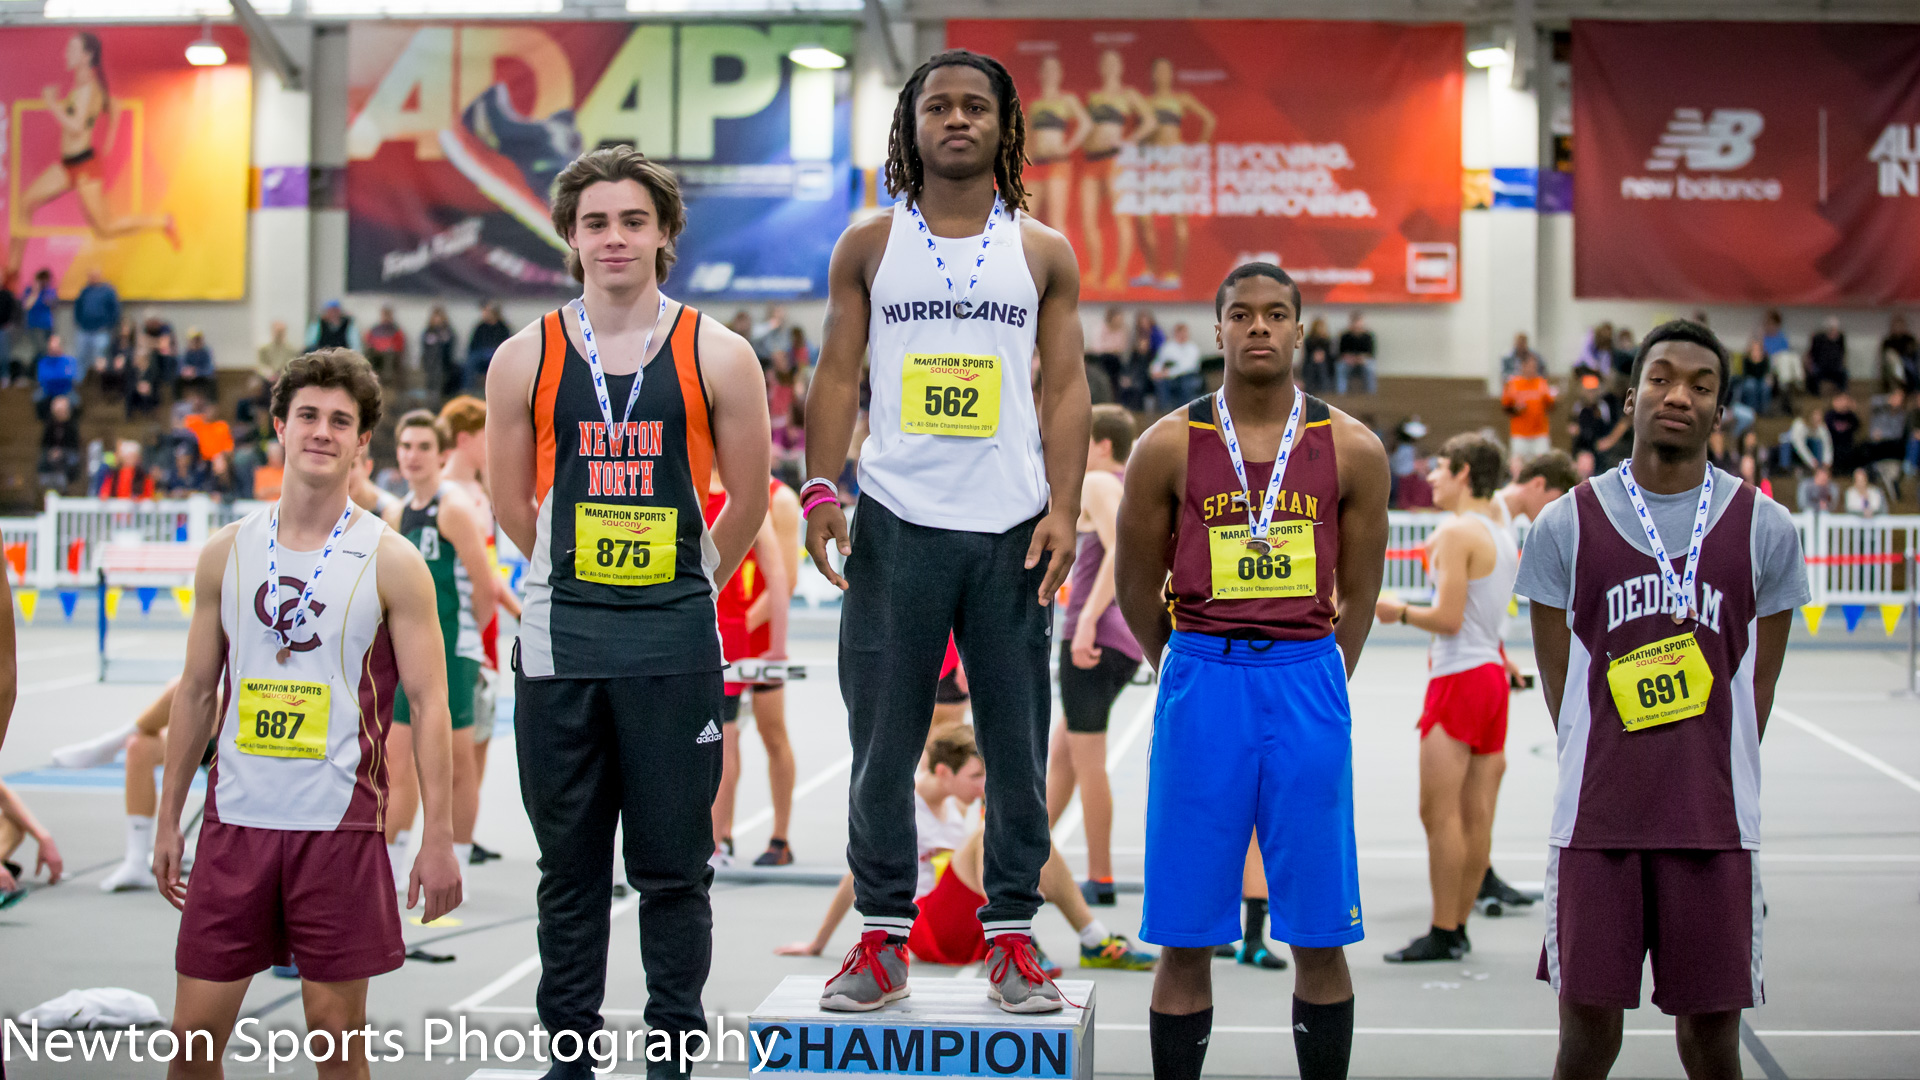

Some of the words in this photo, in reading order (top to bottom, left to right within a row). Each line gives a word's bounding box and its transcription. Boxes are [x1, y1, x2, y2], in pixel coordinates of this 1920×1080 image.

[348, 25, 854, 161] ADAPT
[1677, 176, 1782, 200] balance
[882, 300, 1028, 328] HURRICANES
[914, 357, 960, 367] MARATHON
[962, 358, 994, 369] SPORTS
[930, 366, 971, 377] saucony
[924, 385, 979, 418] 562
[939, 422, 980, 431] Championships
[578, 420, 663, 457] NEWTON
[588, 460, 654, 496] NORTH
[584, 508, 631, 520] MARATHON
[633, 511, 666, 522] SPORTS
[601, 519, 642, 529] saucony
[1269, 525, 1303, 536] SPORTS
[596, 537, 651, 568] 875
[589, 571, 611, 579] All-State
[612, 572, 653, 581] Championships
[1255, 584, 1295, 592] Championships
[1618, 645, 1662, 665] MARATHON
[1664, 637, 1695, 653] SPORTS
[1636, 653, 1675, 668] saucony
[738, 665, 807, 681] UCS
[247, 682, 288, 693] MARATHON
[289, 684, 322, 696] SPORTS
[1637, 669, 1689, 708] 691
[261, 692, 297, 702] saucony
[255, 709, 306, 740] 687
[1636, 713, 1660, 723] All-State
[696, 733, 722, 744] adidas
[757, 1025, 1068, 1076] CHAMPION
